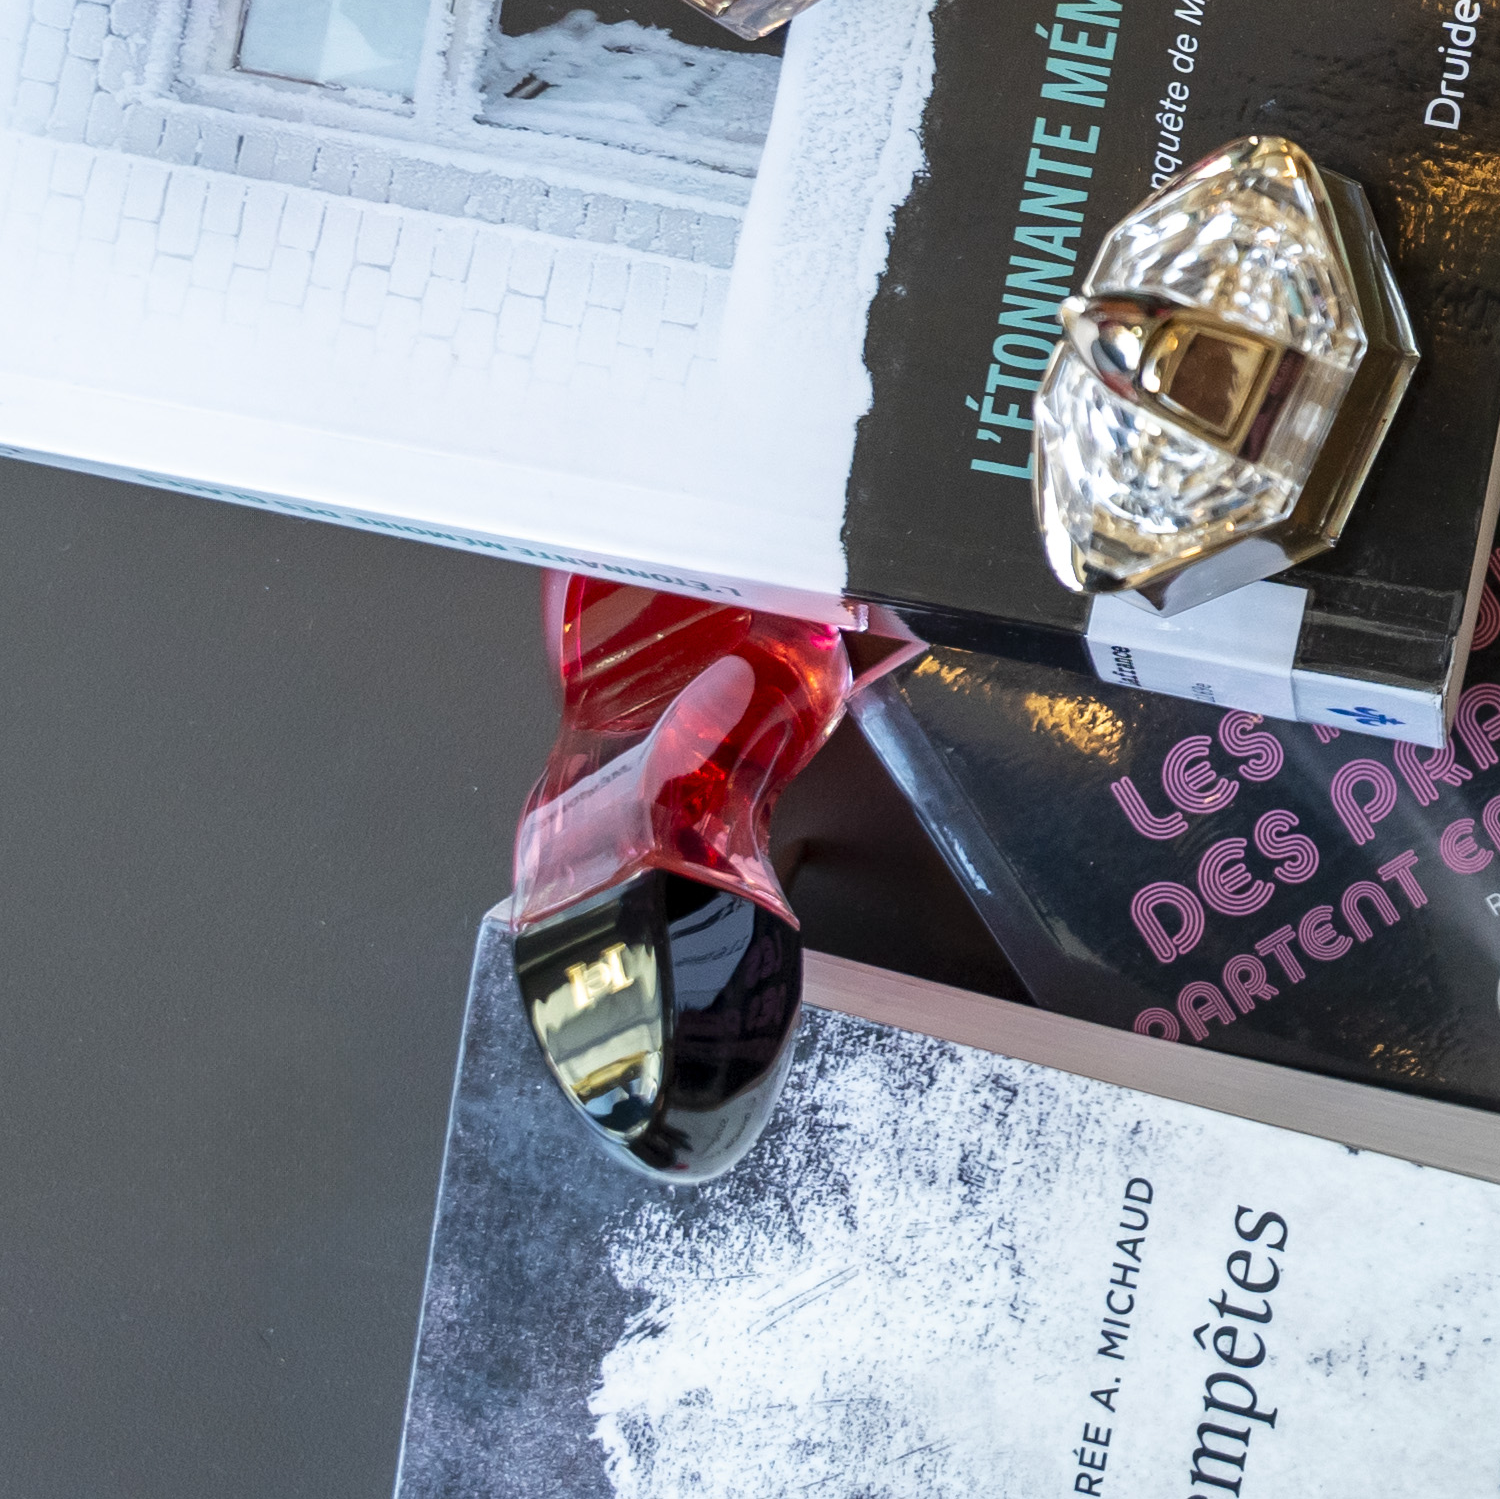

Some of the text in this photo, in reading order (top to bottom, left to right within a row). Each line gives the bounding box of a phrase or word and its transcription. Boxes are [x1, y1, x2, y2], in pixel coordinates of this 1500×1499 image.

[1148, 84, 1190, 193] nquête
[1169, 28, 1200, 83] de
[964, 116, 1098, 482] L'ÉTONNANTE
[1110, 711, 1285, 841] LES
[1130, 809, 1320, 965] DES
[1098, 1175, 1155, 1363] MICHAUD
[1085, 1374, 1122, 1415] A.
